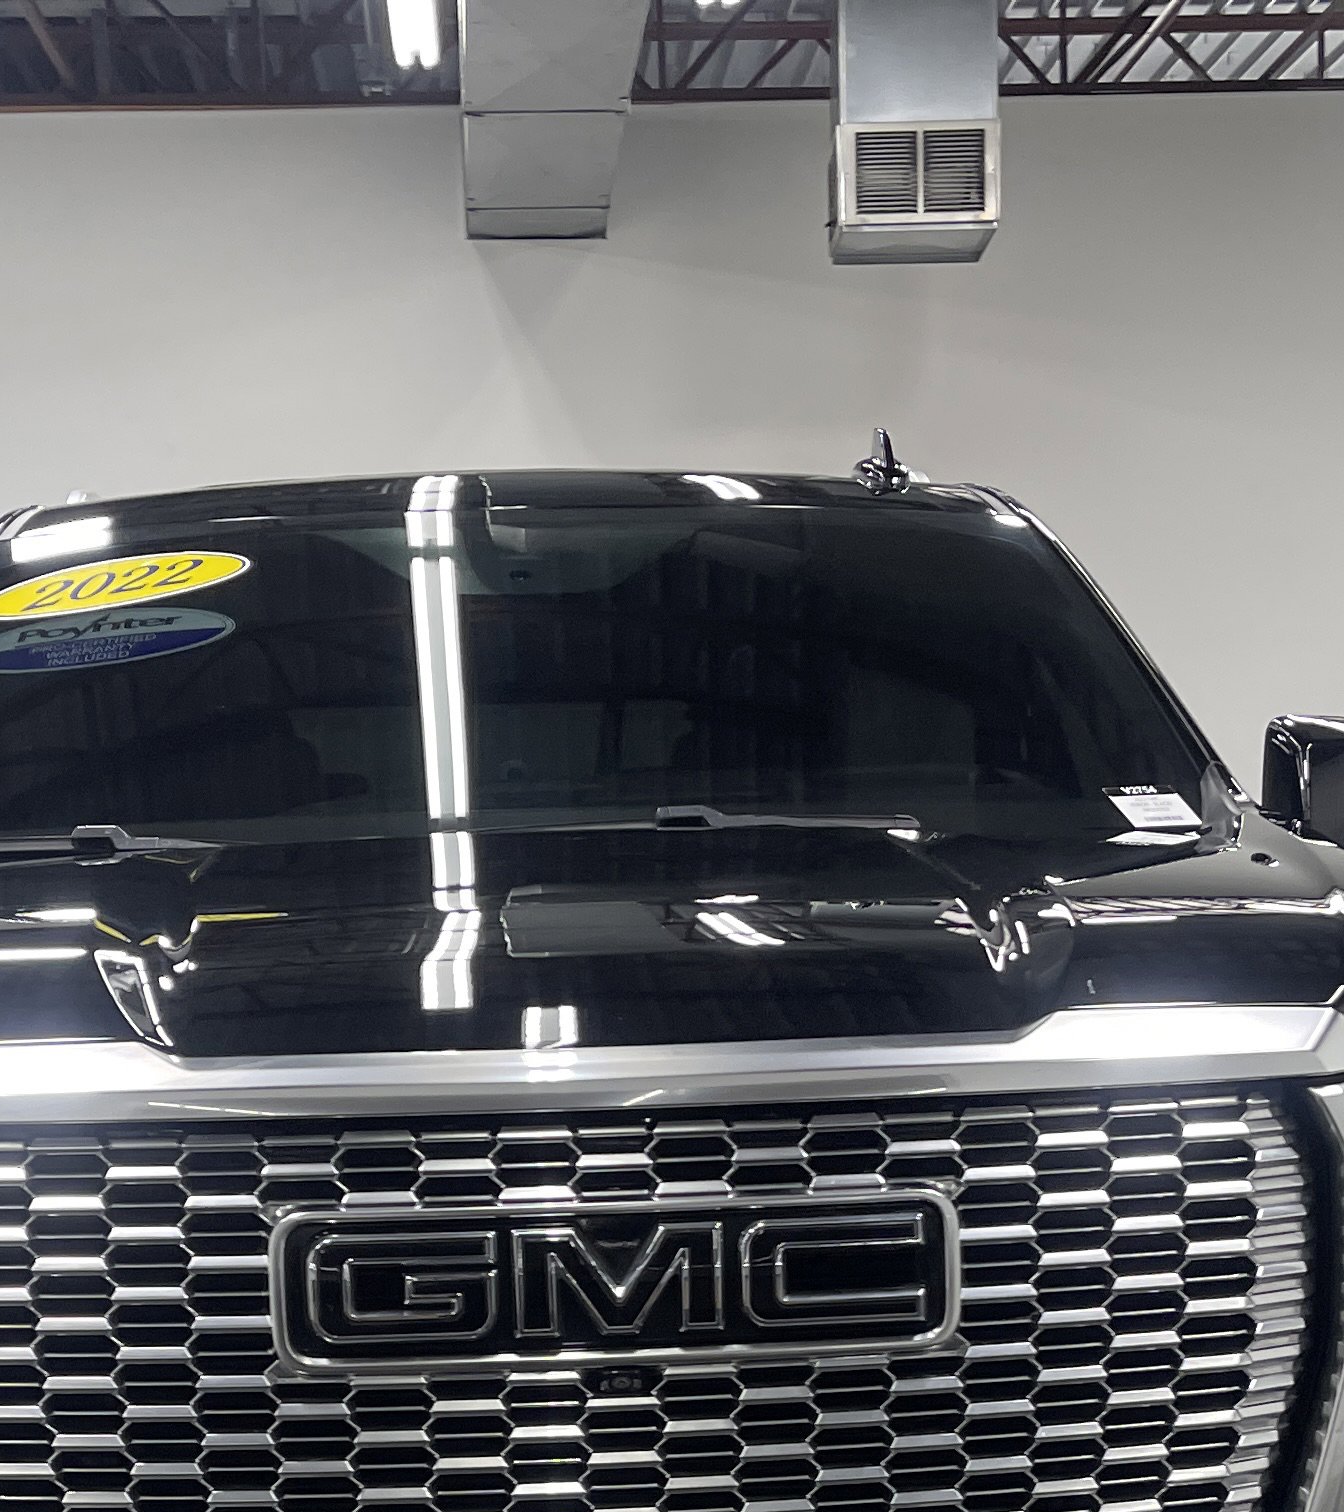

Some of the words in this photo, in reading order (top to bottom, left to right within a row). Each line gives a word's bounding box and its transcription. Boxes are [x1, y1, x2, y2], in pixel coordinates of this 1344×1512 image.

[20, 558, 204, 612] 2022
[17, 613, 183, 643] Poynter
[46, 642, 136, 659] WARRANTY
[47, 650, 130, 667] INCLUDED
[308, 1212, 926, 1344] GMC
